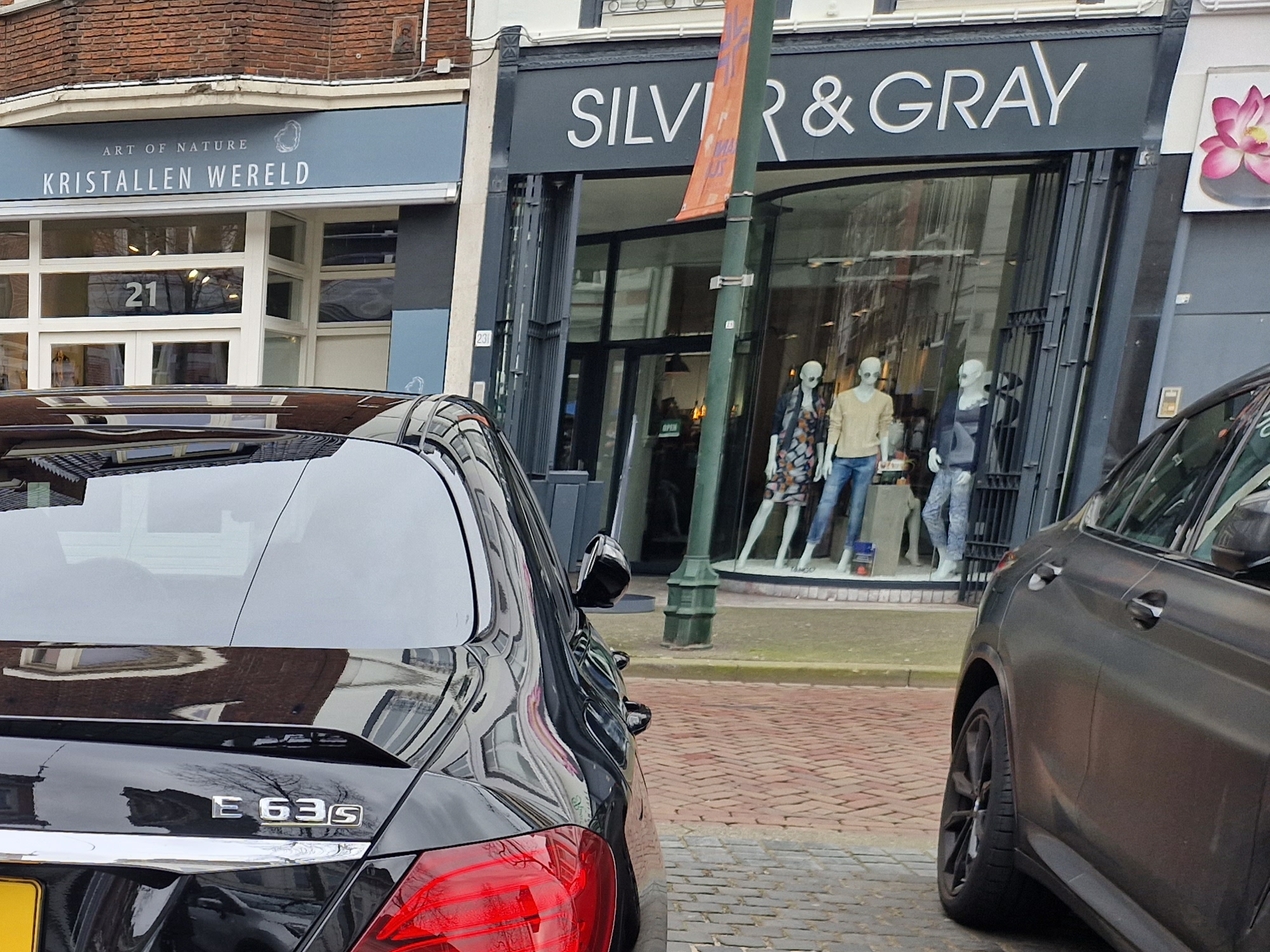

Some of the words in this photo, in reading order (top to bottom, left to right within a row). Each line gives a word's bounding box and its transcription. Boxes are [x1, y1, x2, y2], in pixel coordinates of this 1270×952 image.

[567, 80, 787, 162] SILVR
[801, 74, 855, 138] &
[868, 41, 1089, 134] GRAY
[102, 144, 135, 157] ART
[145, 142, 167, 154] OF
[176, 138, 248, 153] NATURE
[43, 167, 192, 195] KRISTALLEN
[208, 161, 309, 188] WERELD
[125, 281, 157, 307] 21
[211, 795, 243, 819] E
